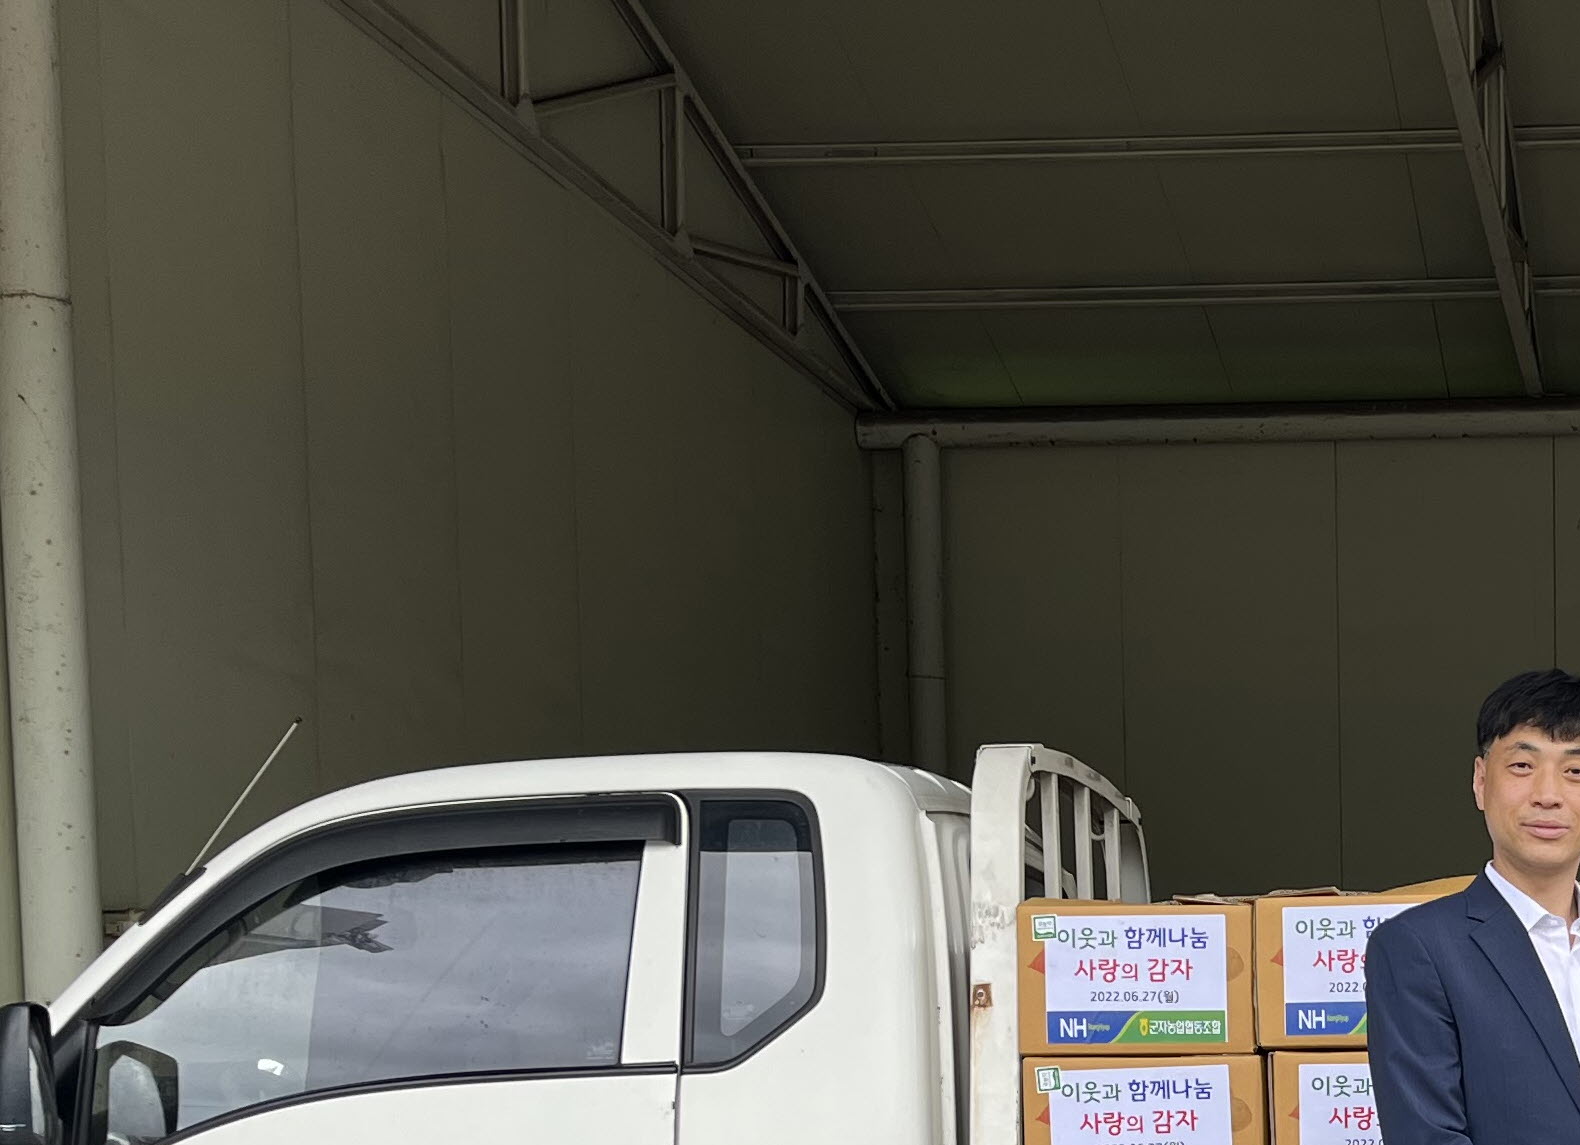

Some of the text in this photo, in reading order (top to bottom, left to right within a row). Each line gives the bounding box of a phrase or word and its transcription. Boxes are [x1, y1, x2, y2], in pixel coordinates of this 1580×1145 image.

[1058, 926, 1209, 949] 이웃과 함께나눔
[1296, 918, 1356, 940] 이웃과
[1075, 959, 1193, 983] 사랑의 감자
[1313, 949, 1367, 974] 사랑
[1090, 990, 1180, 1004] 2022.06.27(월)
[1060, 1018, 1087, 1038] NH
[1299, 1009, 1326, 1029] NH
[1061, 1078, 1213, 1103] 이웃과 함께나눔
[1311, 1076, 1373, 1097] 이웃과
[1080, 1109, 1199, 1136] 사랑의 감자
[1329, 1107, 1380, 1131] 사랑
